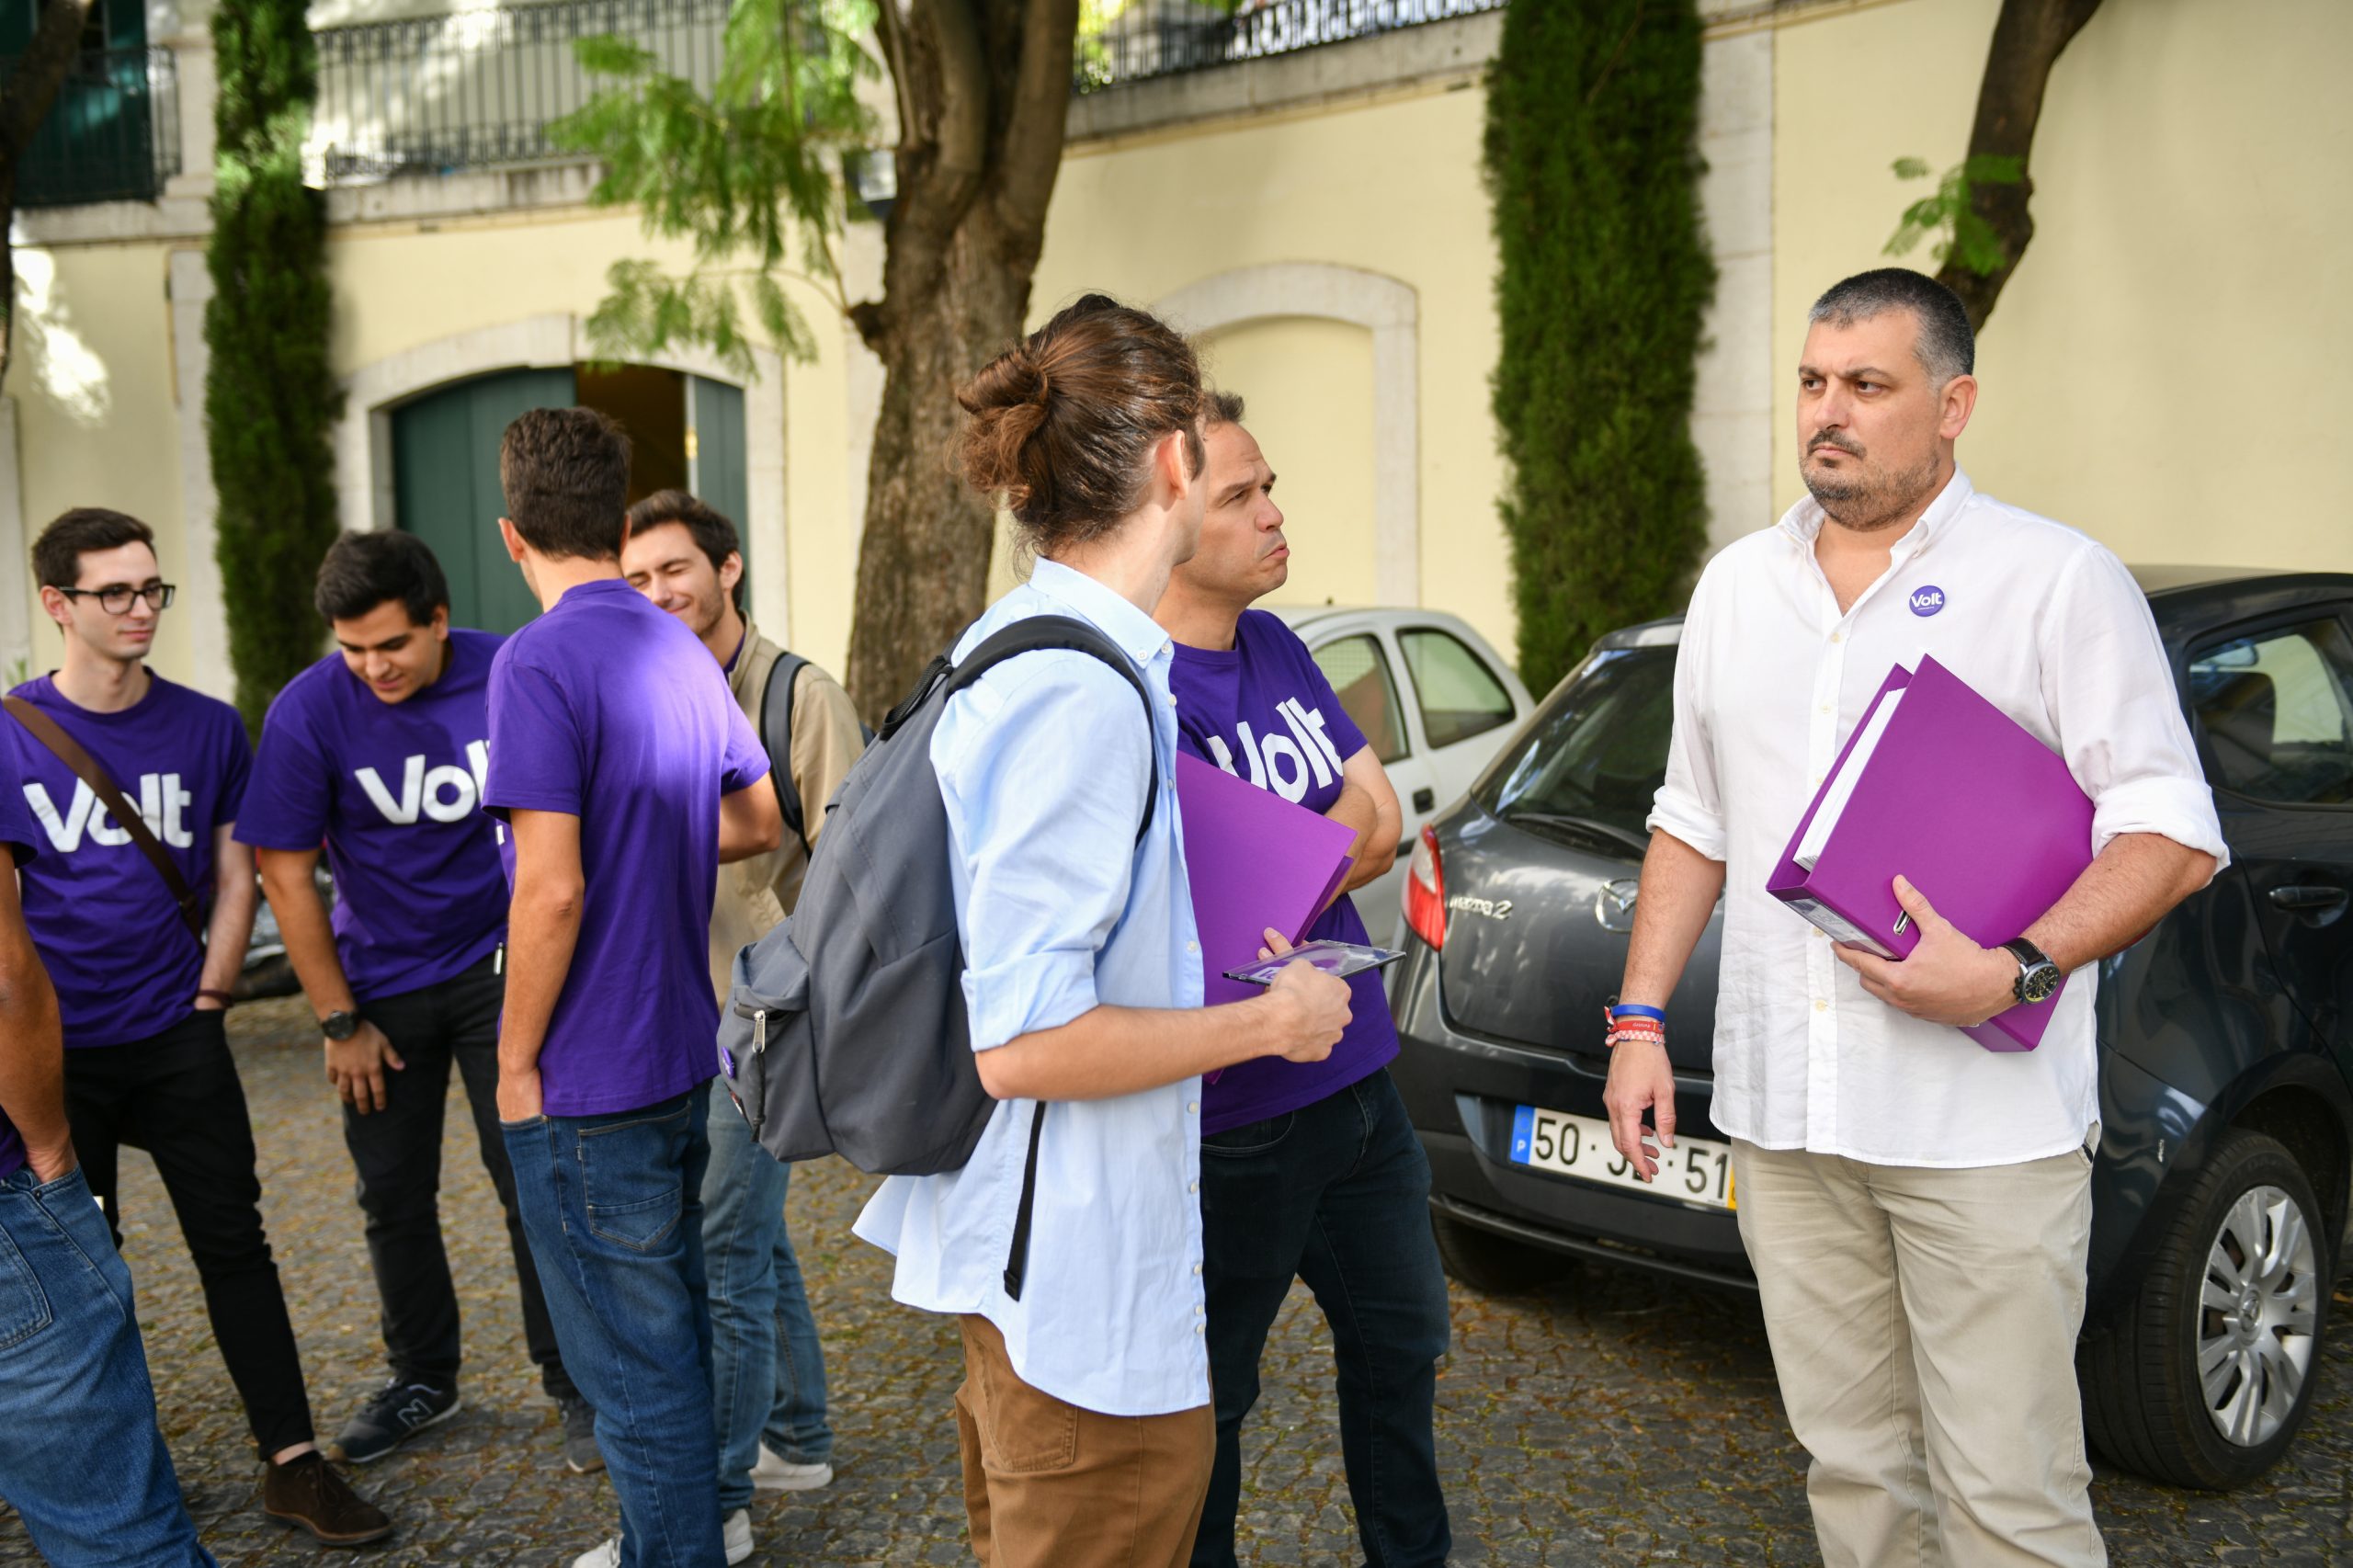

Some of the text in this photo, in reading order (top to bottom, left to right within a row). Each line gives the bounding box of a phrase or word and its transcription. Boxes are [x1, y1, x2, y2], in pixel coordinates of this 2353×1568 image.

[1911, 592, 1943, 608] Volt
[354, 739, 491, 824] Vol
[1206, 697, 1344, 803] Volt
[22, 773, 193, 853] Volt
[1518, 1140, 1527, 1153] P
